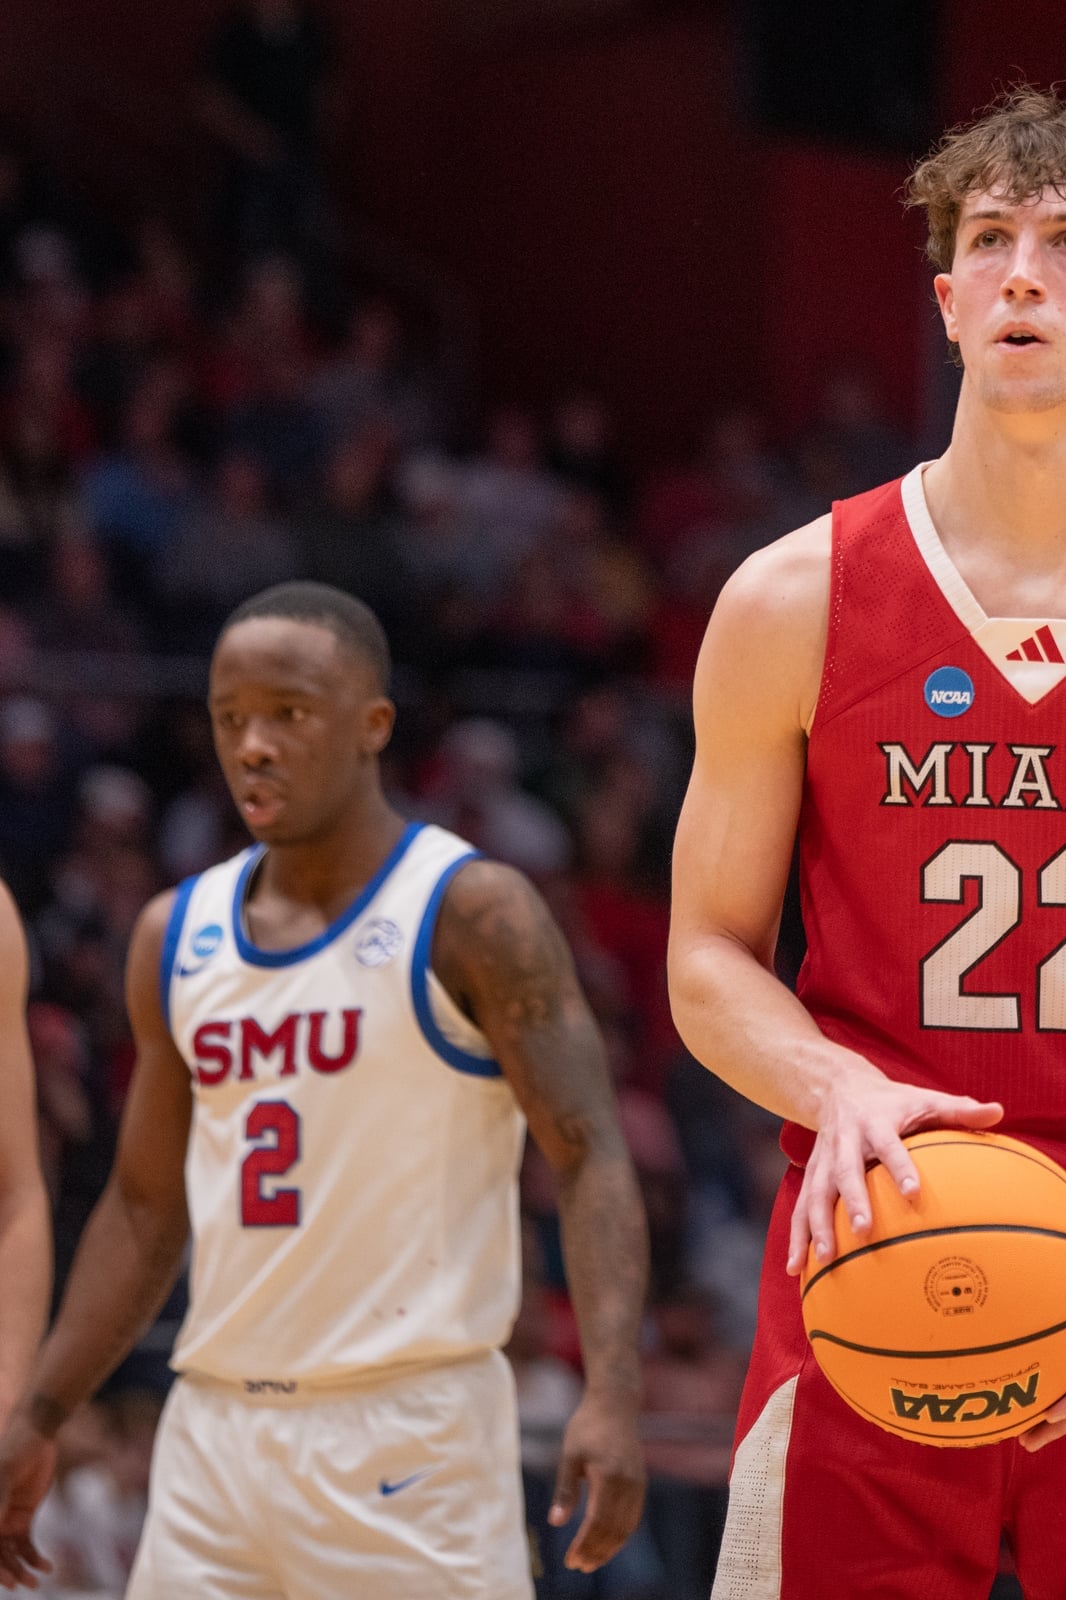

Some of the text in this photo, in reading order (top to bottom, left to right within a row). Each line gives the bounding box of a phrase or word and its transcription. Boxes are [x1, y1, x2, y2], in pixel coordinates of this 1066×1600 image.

[930, 689, 972, 705] NCAA
[191, 1007, 364, 1088] SMU
[241, 1098, 300, 1228] 2
[890, 1361, 1040, 1391] OFFICIAL GAME BALL
[890, 1371, 1040, 1423] NCAA
